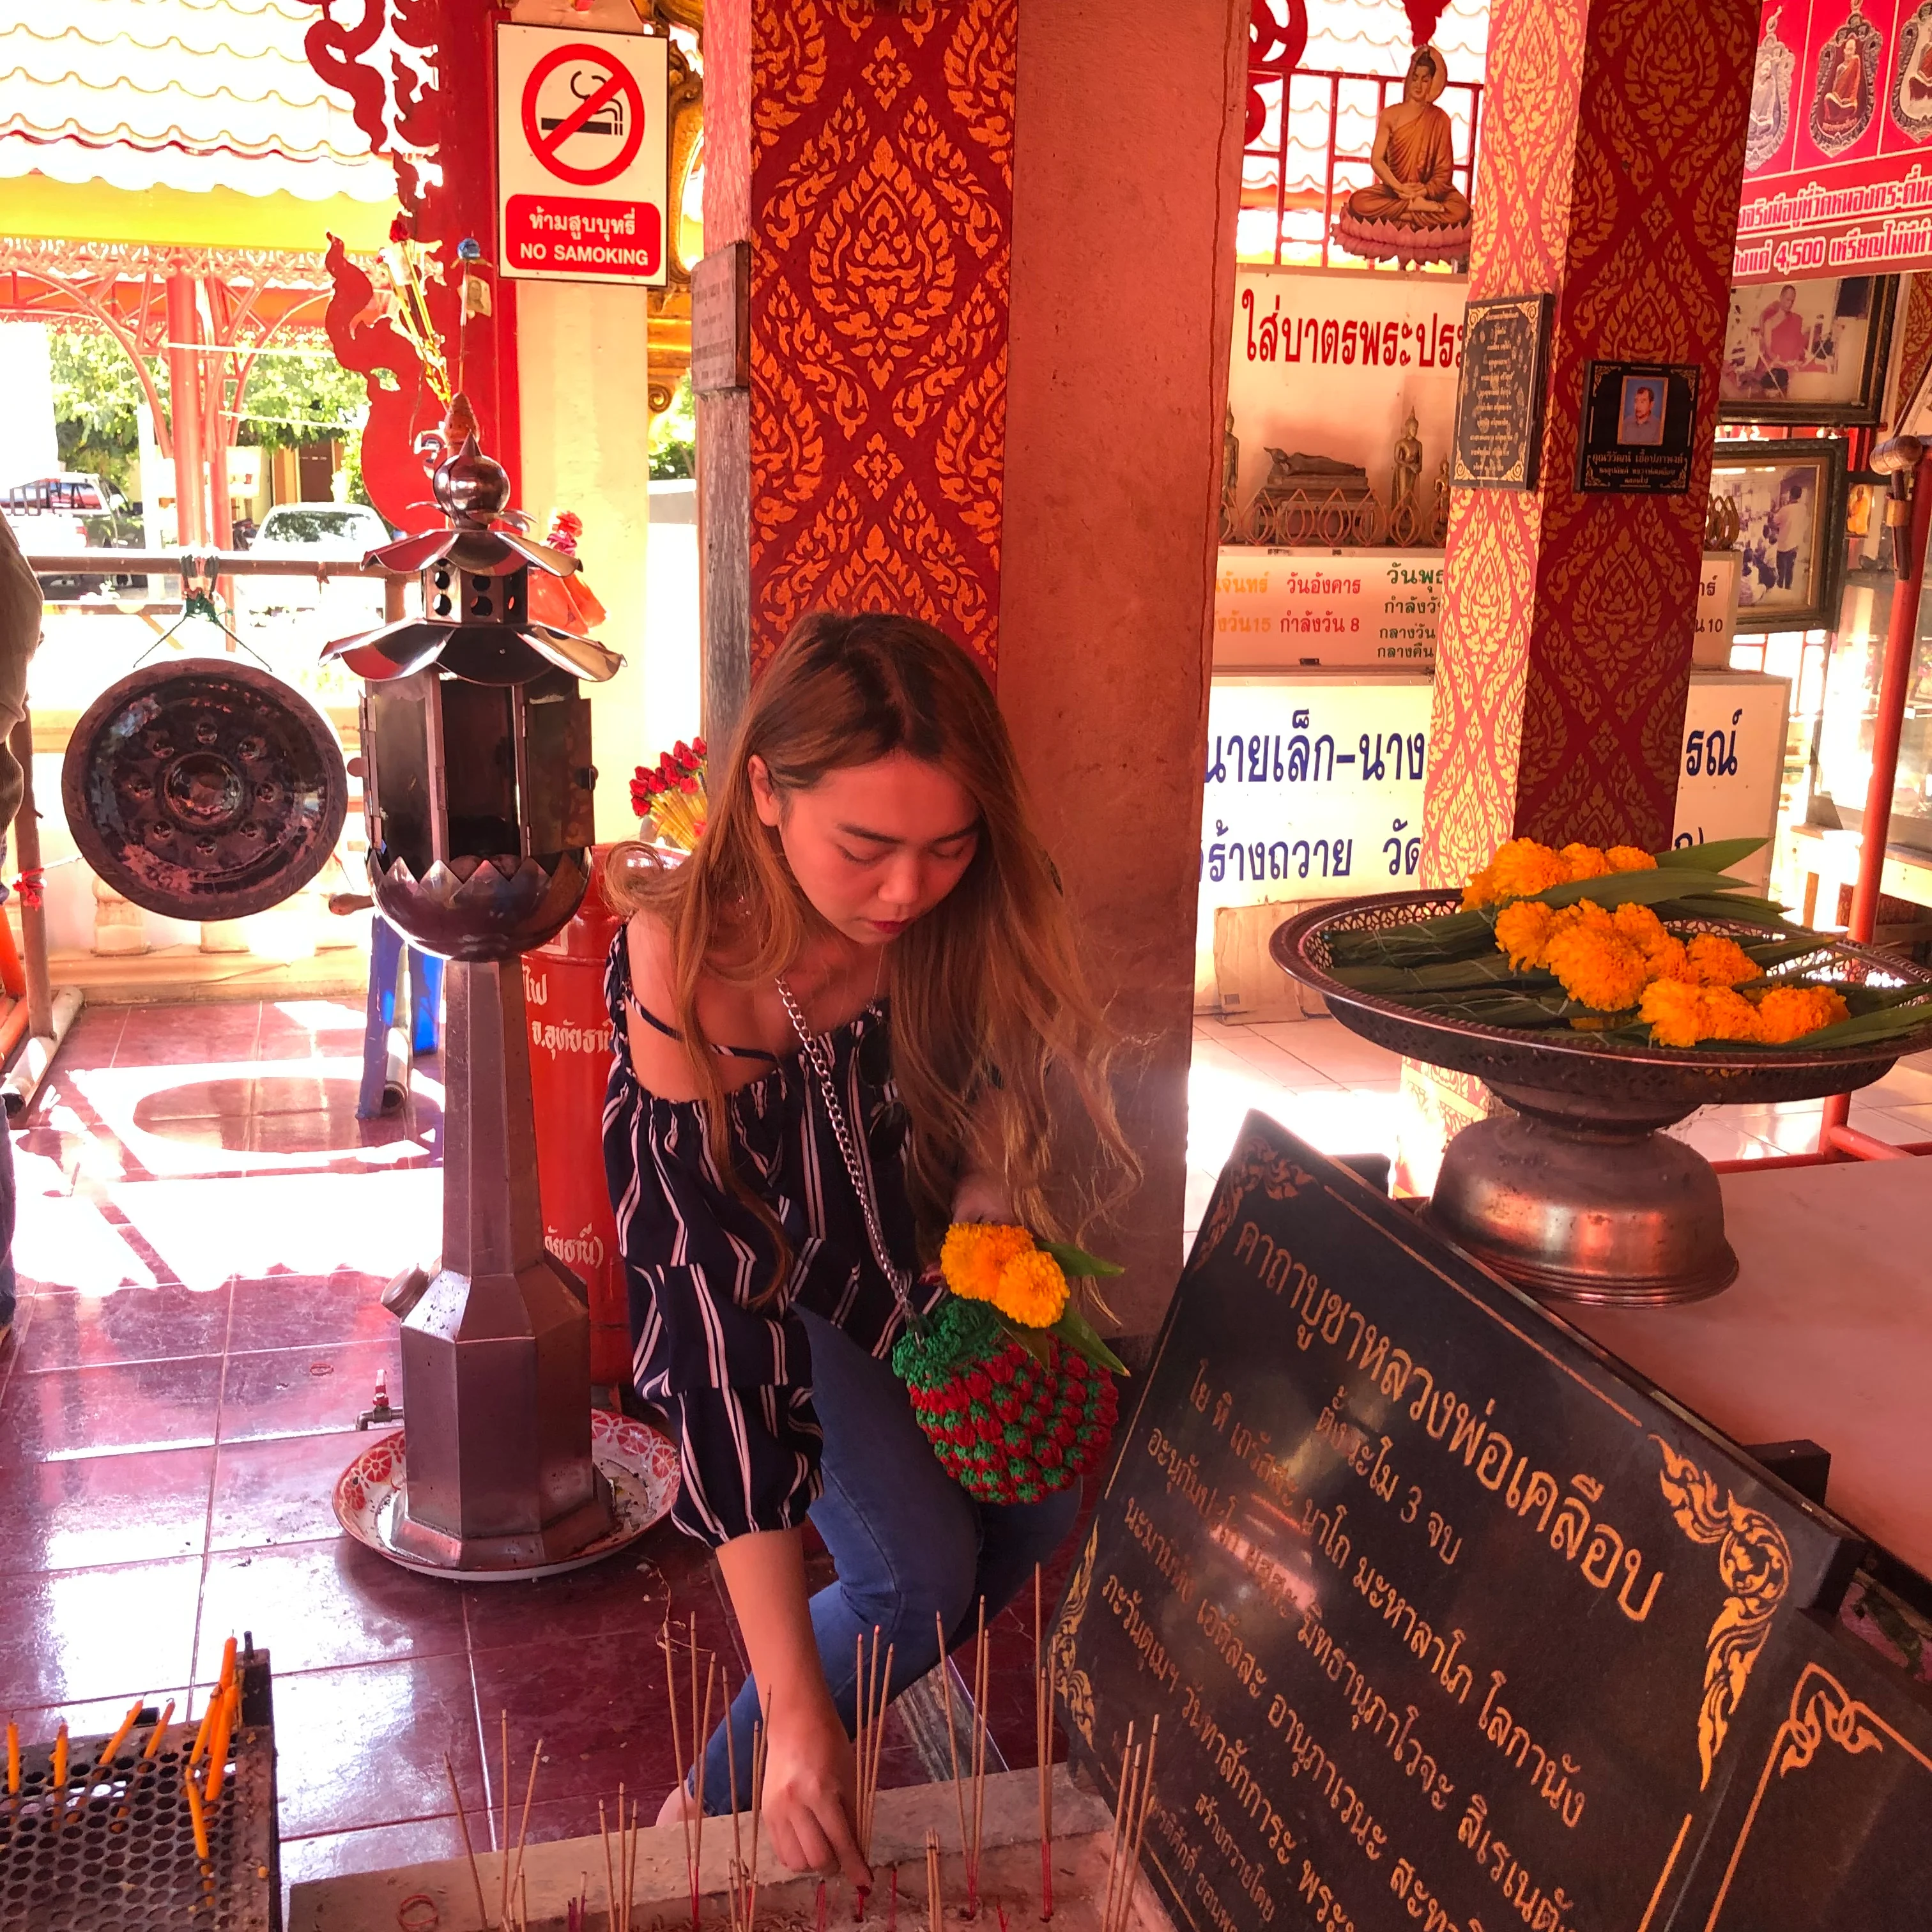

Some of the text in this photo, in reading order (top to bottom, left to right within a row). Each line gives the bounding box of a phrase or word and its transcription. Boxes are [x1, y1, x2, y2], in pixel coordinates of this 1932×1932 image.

[529, 206, 635, 242] ห้ามสูบบุหรี่
[521, 243, 648, 266] NO SAMOKING
[1775, 241, 1824, 273] 4,500
[1287, 572, 1361, 594] วันอังคาร
[1280, 610, 1360, 632] กำลังวัน 8
[1384, 595, 1441, 613] กำลังวั
[1379, 623, 1436, 639] กลางวัน
[1377, 641, 1434, 658] กลางคืน
[1200, 819, 1353, 882] ร้างถวาย
[1234, 1221, 1664, 1623] คาถาบูชาหลวงพ่อเคลือบ
[1400, 1485, 1423, 1523] 3
[1427, 1511, 1462, 1565] จบ
[1353, 1556, 1473, 1705] มะหาลาโภ
[1477, 1669, 1586, 1829] โลกานัง
[1268, 1693, 1388, 1861] อานุภาเวนะ
[1195, 1793, 1275, 1922] สร้างถวายโดย
[1457, 1793, 1576, 1932] สิเรเนตั
